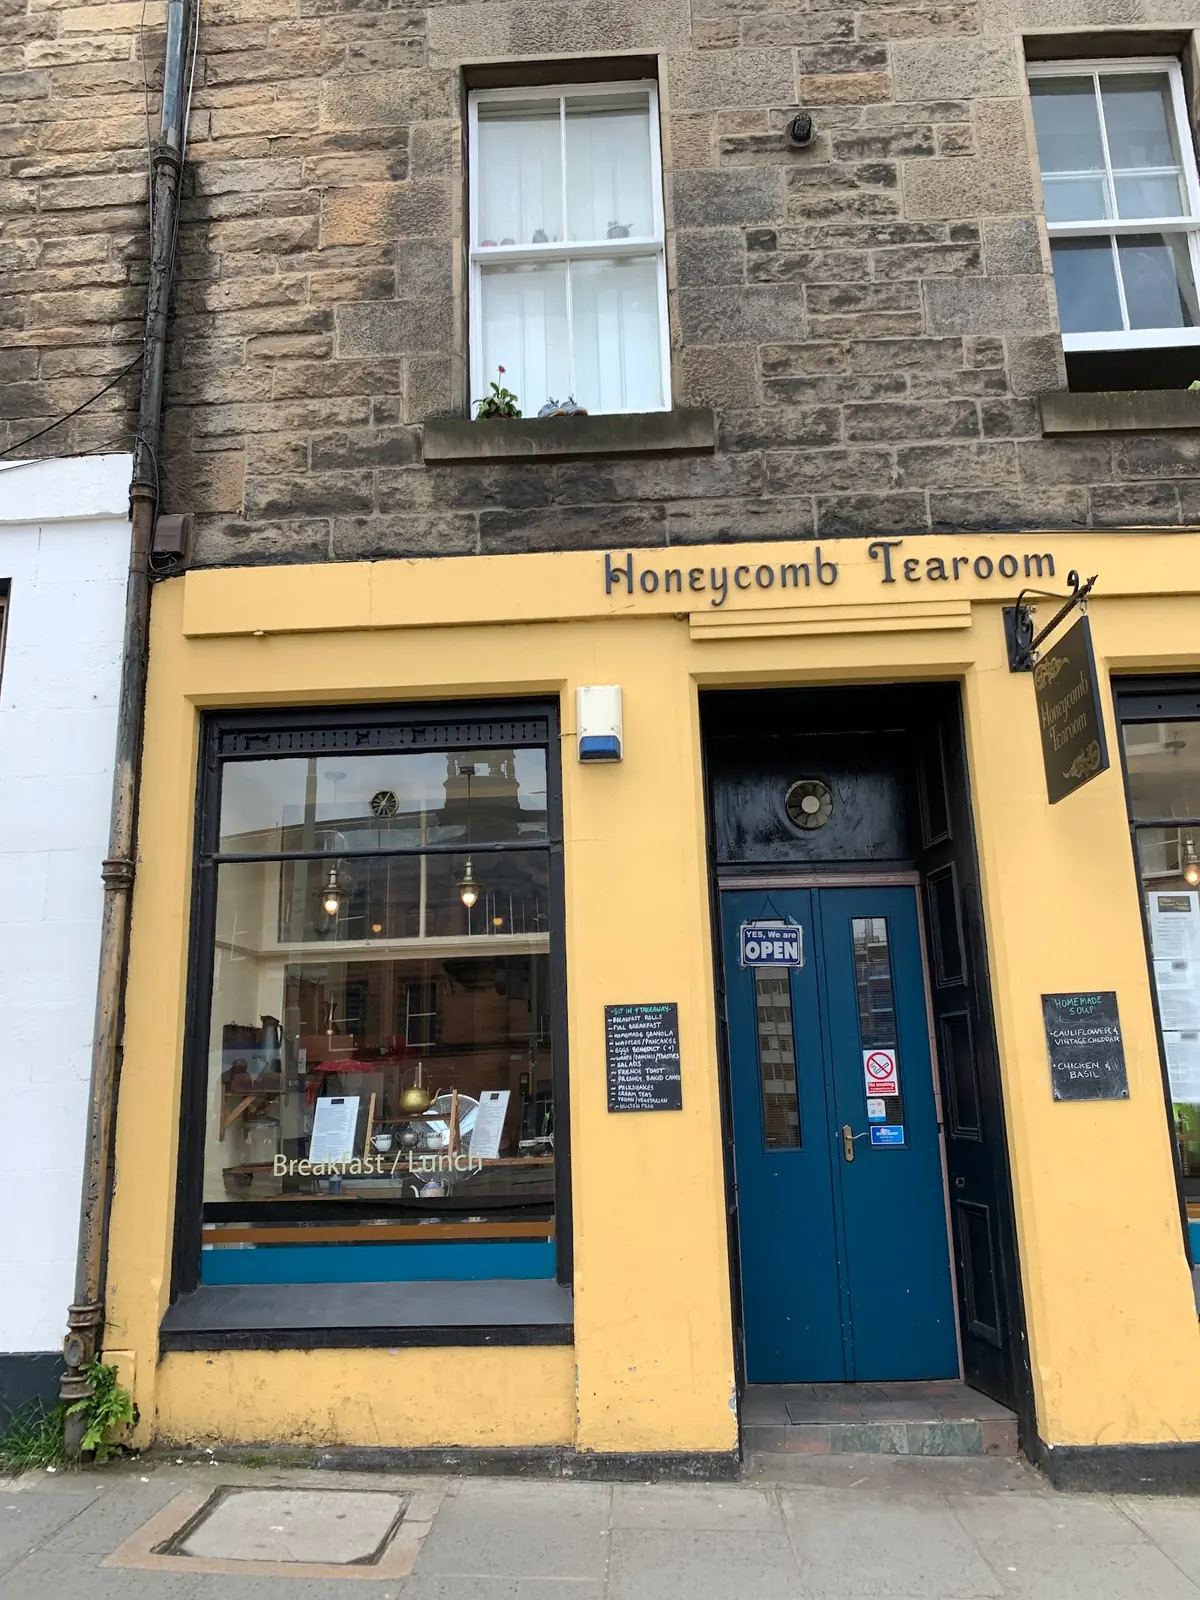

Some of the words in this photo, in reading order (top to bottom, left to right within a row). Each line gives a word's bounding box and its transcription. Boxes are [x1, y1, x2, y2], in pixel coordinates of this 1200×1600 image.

[604, 546, 838, 607] Honeycomb
[868, 539, 1056, 583] Tearoom
[1040, 670, 1088, 730] Honeycomb
[1049, 712, 1088, 752] Tearoom
[745, 930, 766, 939] YES,
[767, 930, 781, 938] We
[745, 940, 798, 959] OPEN
[1069, 1006, 1094, 1015] SOUP
[628, 1022, 662, 1030] BREAKFAST
[645, 1030, 674, 1038] GRANOLA
[616, 1060, 642, 1068] SALADS
[1057, 1061, 1100, 1070] CHICKEN
[1069, 1070, 1100, 1079] BASIL
[273, 1150, 385, 1177] Breakfast
[408, 1150, 483, 1173] Lunch
